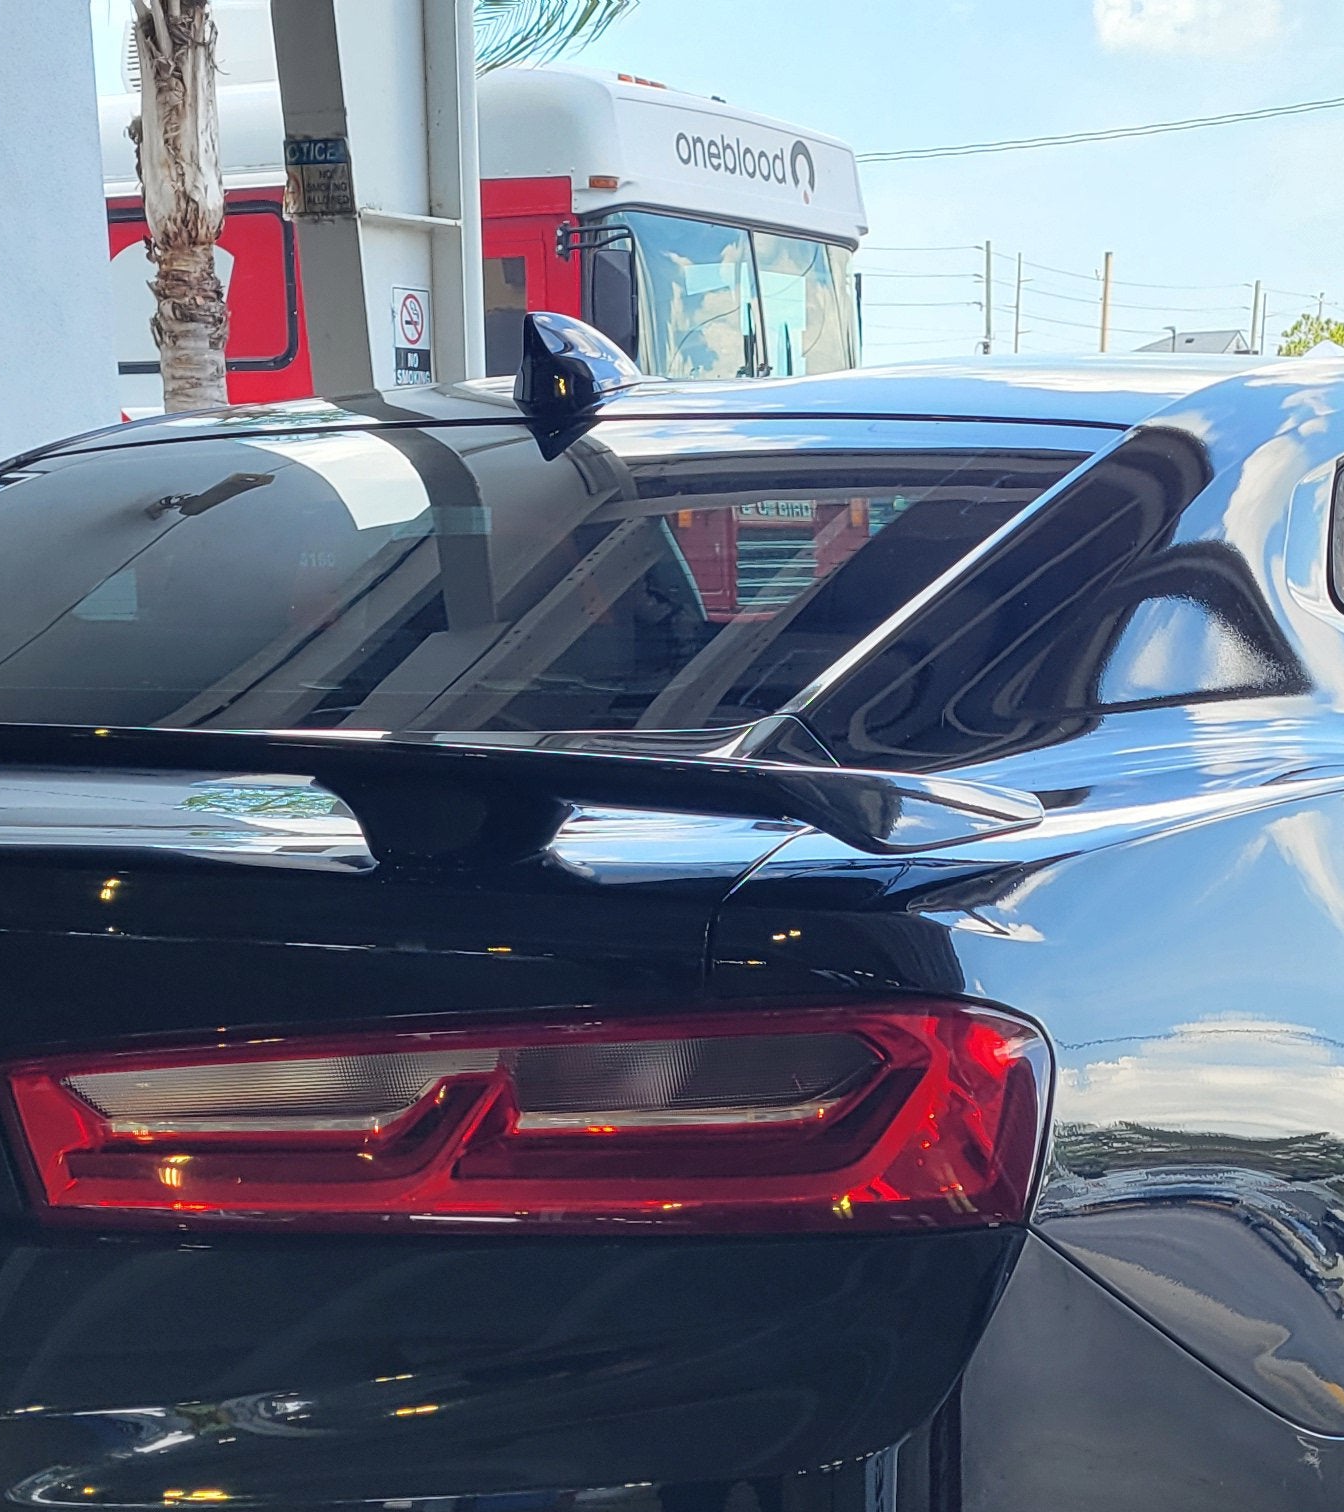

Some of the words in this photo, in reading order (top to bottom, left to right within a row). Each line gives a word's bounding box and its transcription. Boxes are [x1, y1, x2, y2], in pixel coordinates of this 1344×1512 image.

[286, 142, 337, 161] OTICE
[676, 132, 787, 185] oneblood
[407, 352, 419, 369] NO
[397, 369, 431, 385] SMOKING
